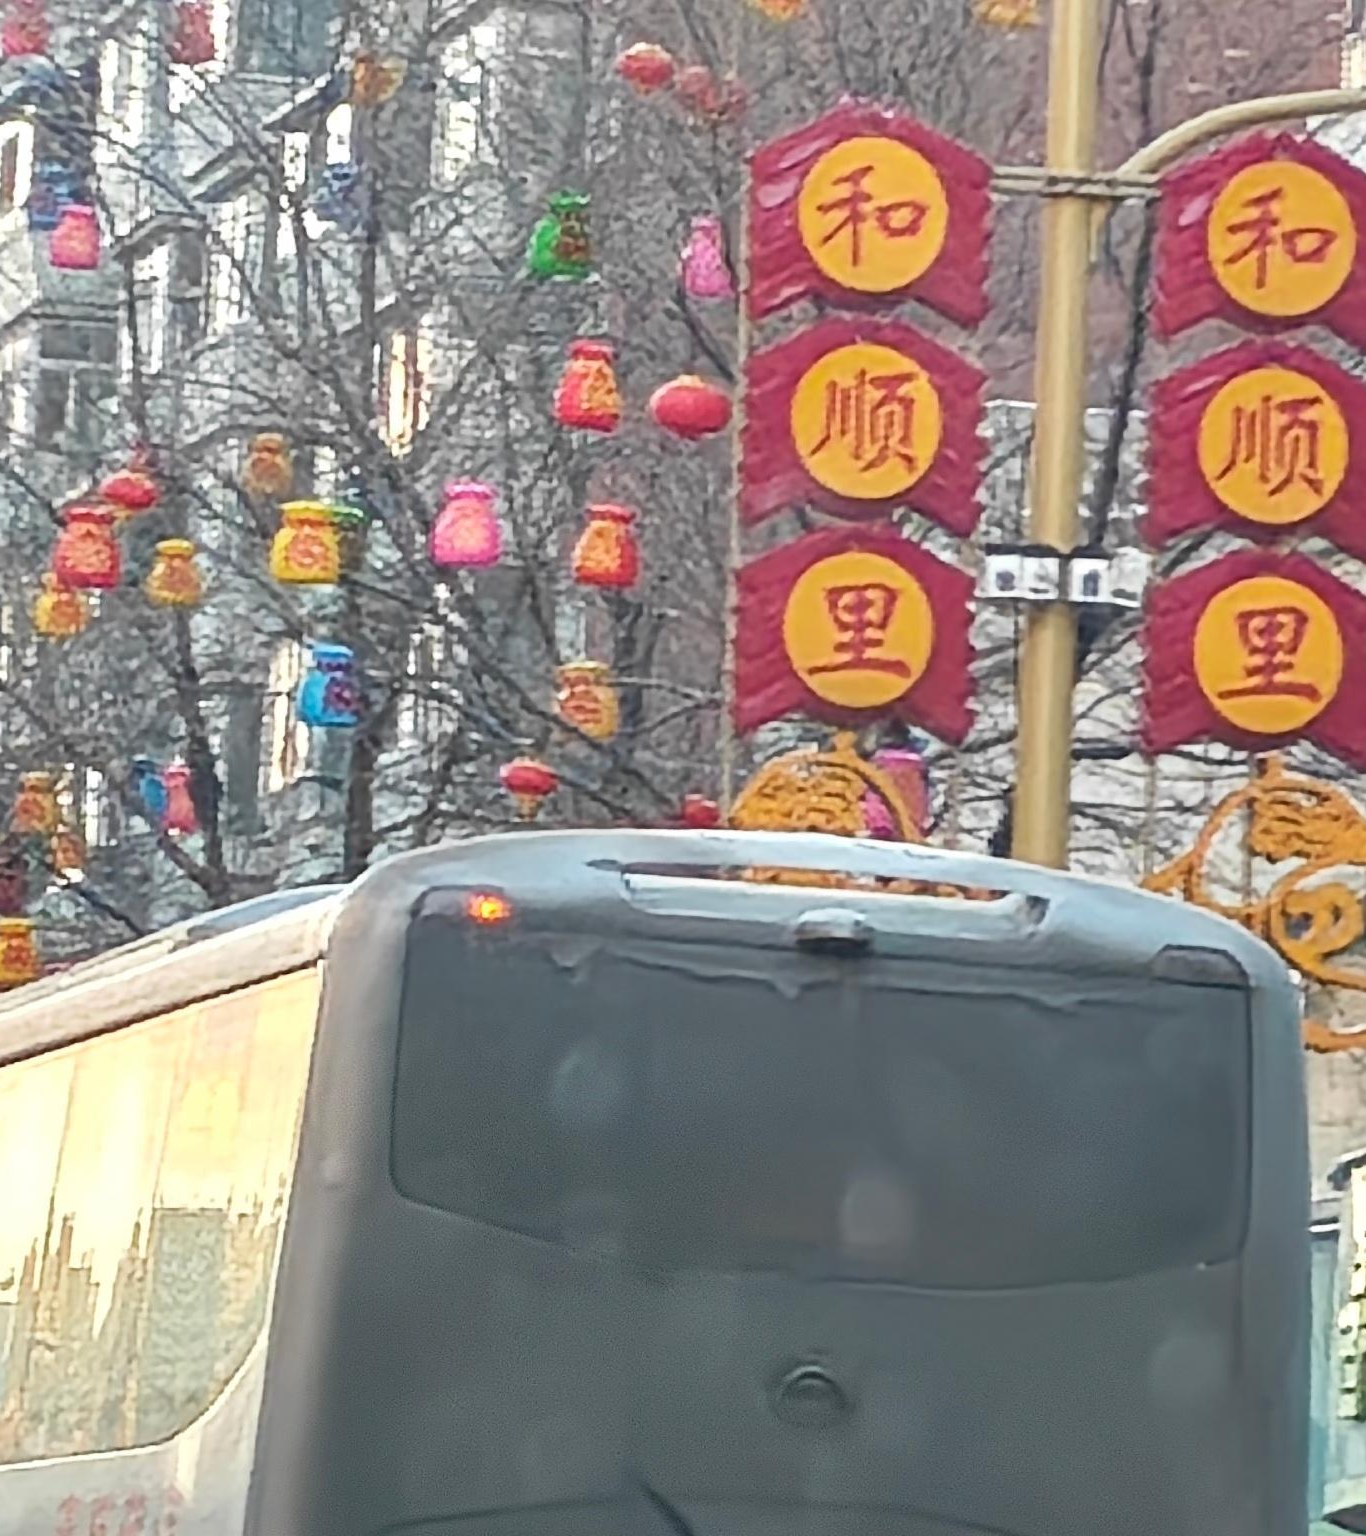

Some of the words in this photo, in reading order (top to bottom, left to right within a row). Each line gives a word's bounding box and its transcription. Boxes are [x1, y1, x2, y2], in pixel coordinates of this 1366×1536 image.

[808, 163, 927, 680] 和顺里
[1216, 186, 1339, 703] 和顺里
